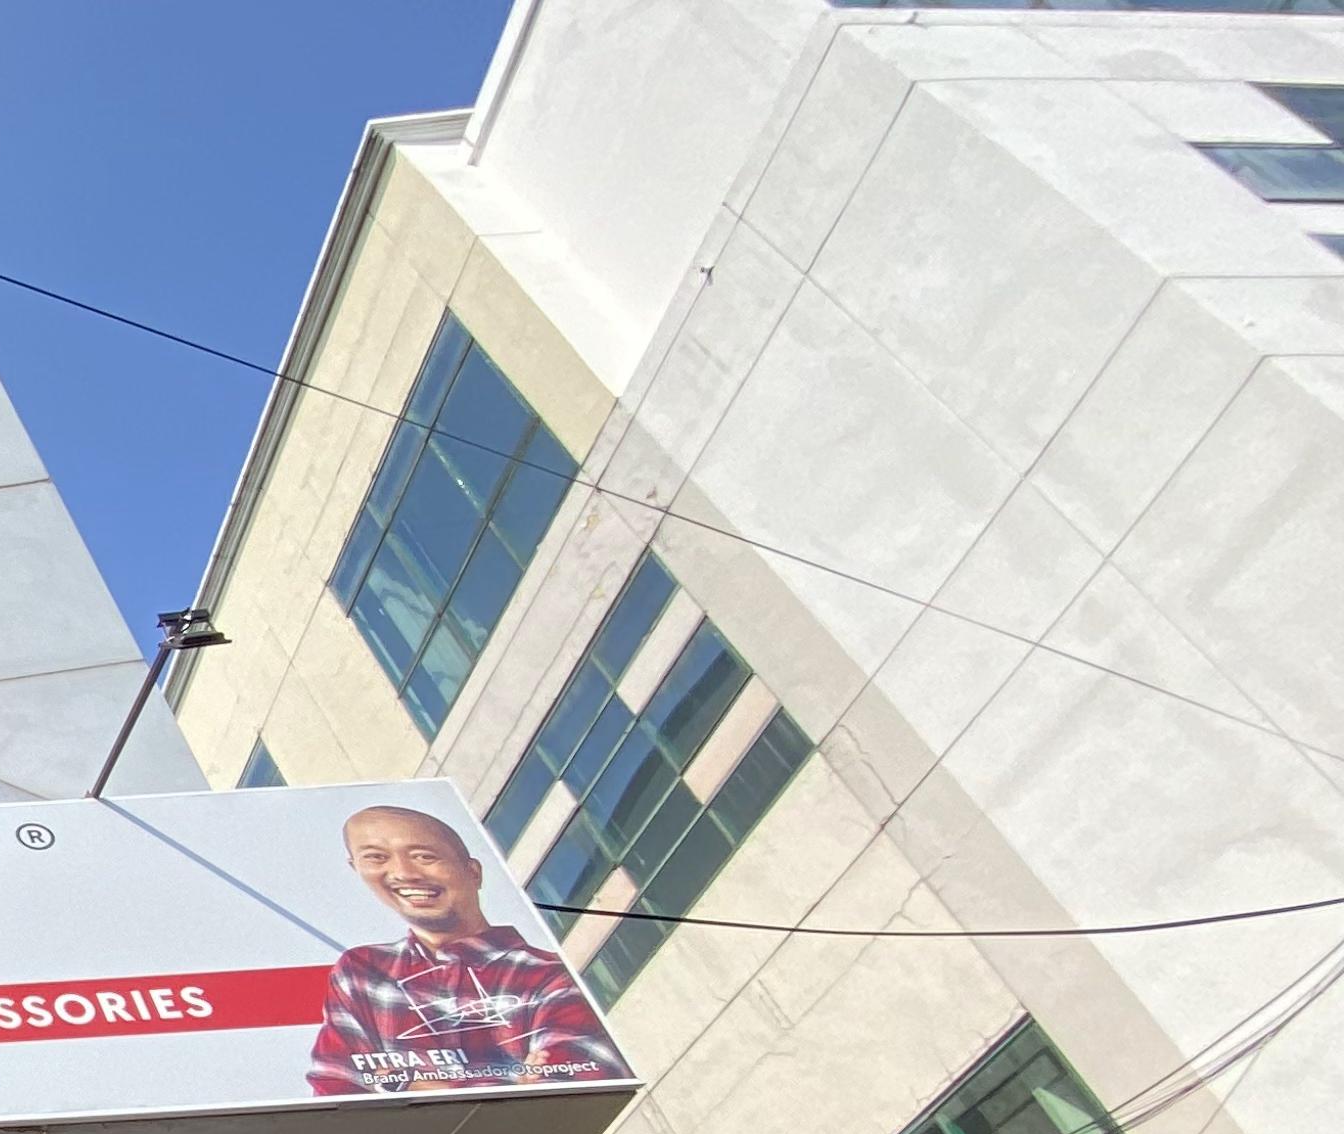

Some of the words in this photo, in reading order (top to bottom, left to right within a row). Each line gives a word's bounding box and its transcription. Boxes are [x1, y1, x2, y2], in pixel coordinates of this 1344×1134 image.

[351, 1050, 424, 1071] FITRA
[429, 1048, 470, 1067] ERI
[362, 1070, 410, 1085] Brand
[413, 1063, 511, 1082] Ambassador
[512, 1060, 600, 1079] Otoproject
